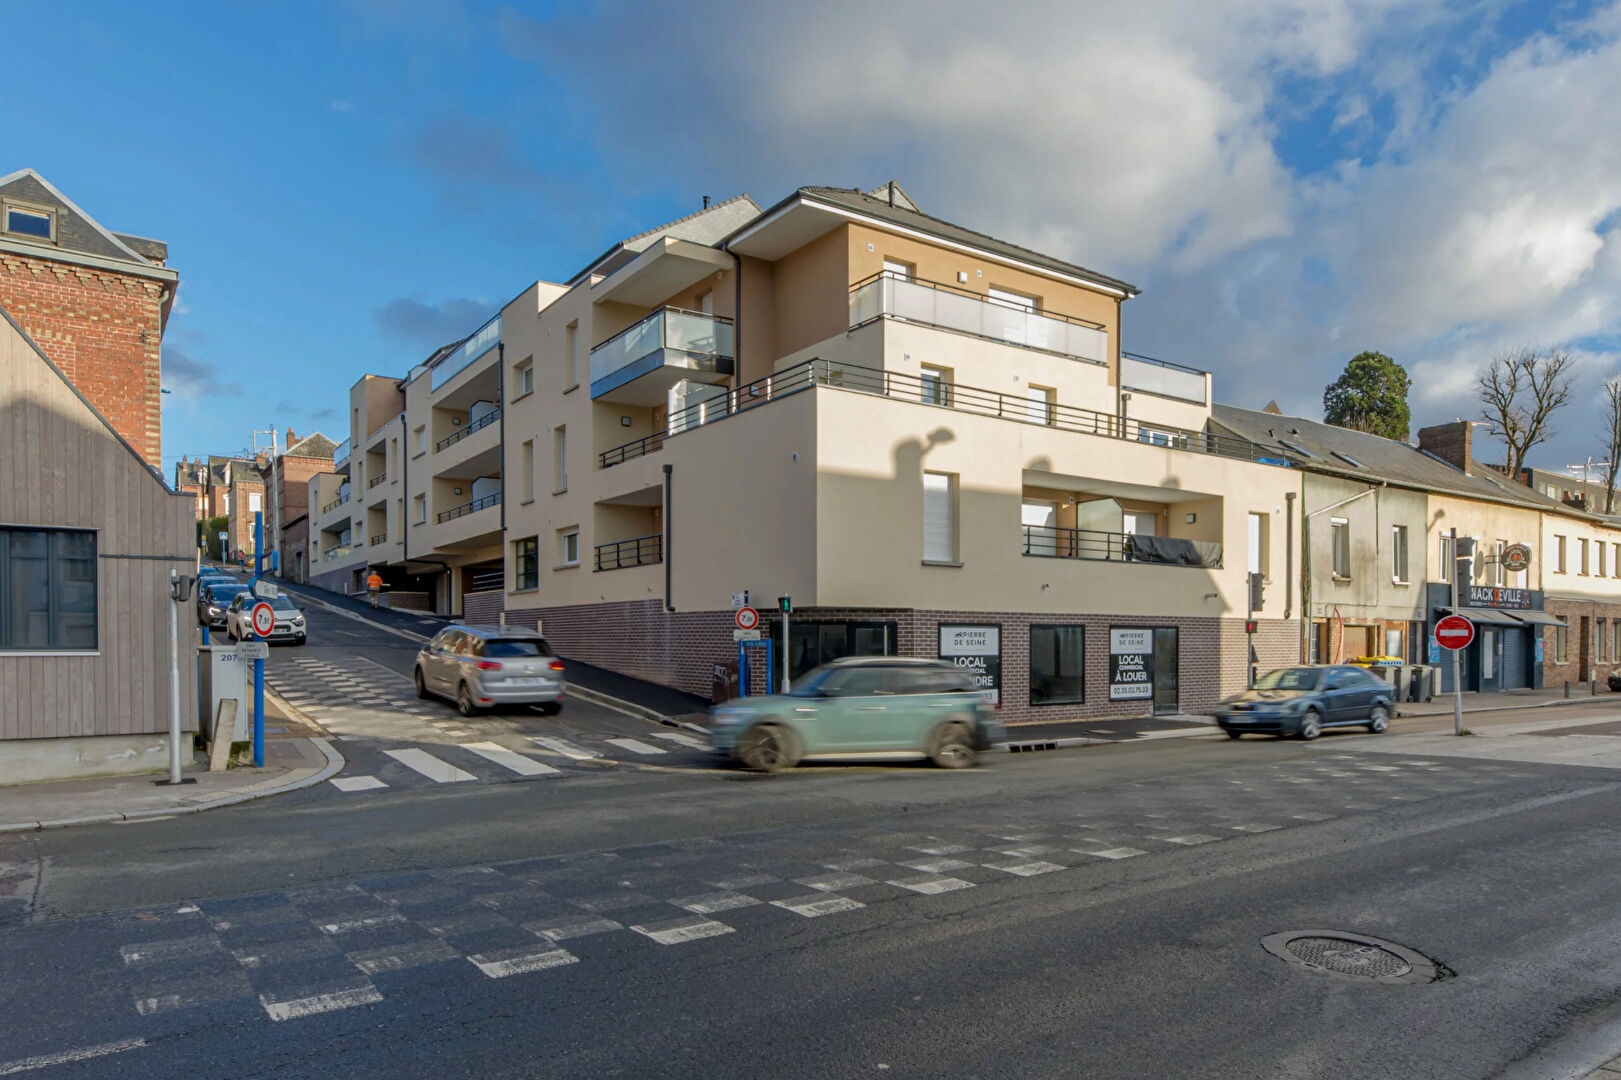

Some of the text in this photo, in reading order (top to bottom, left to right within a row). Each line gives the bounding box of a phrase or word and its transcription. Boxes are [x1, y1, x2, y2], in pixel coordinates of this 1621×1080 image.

[1471, 586, 1493, 601] NACK
[221, 654, 238, 662] 207
[953, 656, 987, 668] LOCAL
[1118, 655, 1144, 665] LOCAL
[1115, 669, 1147, 682] À LOUER
